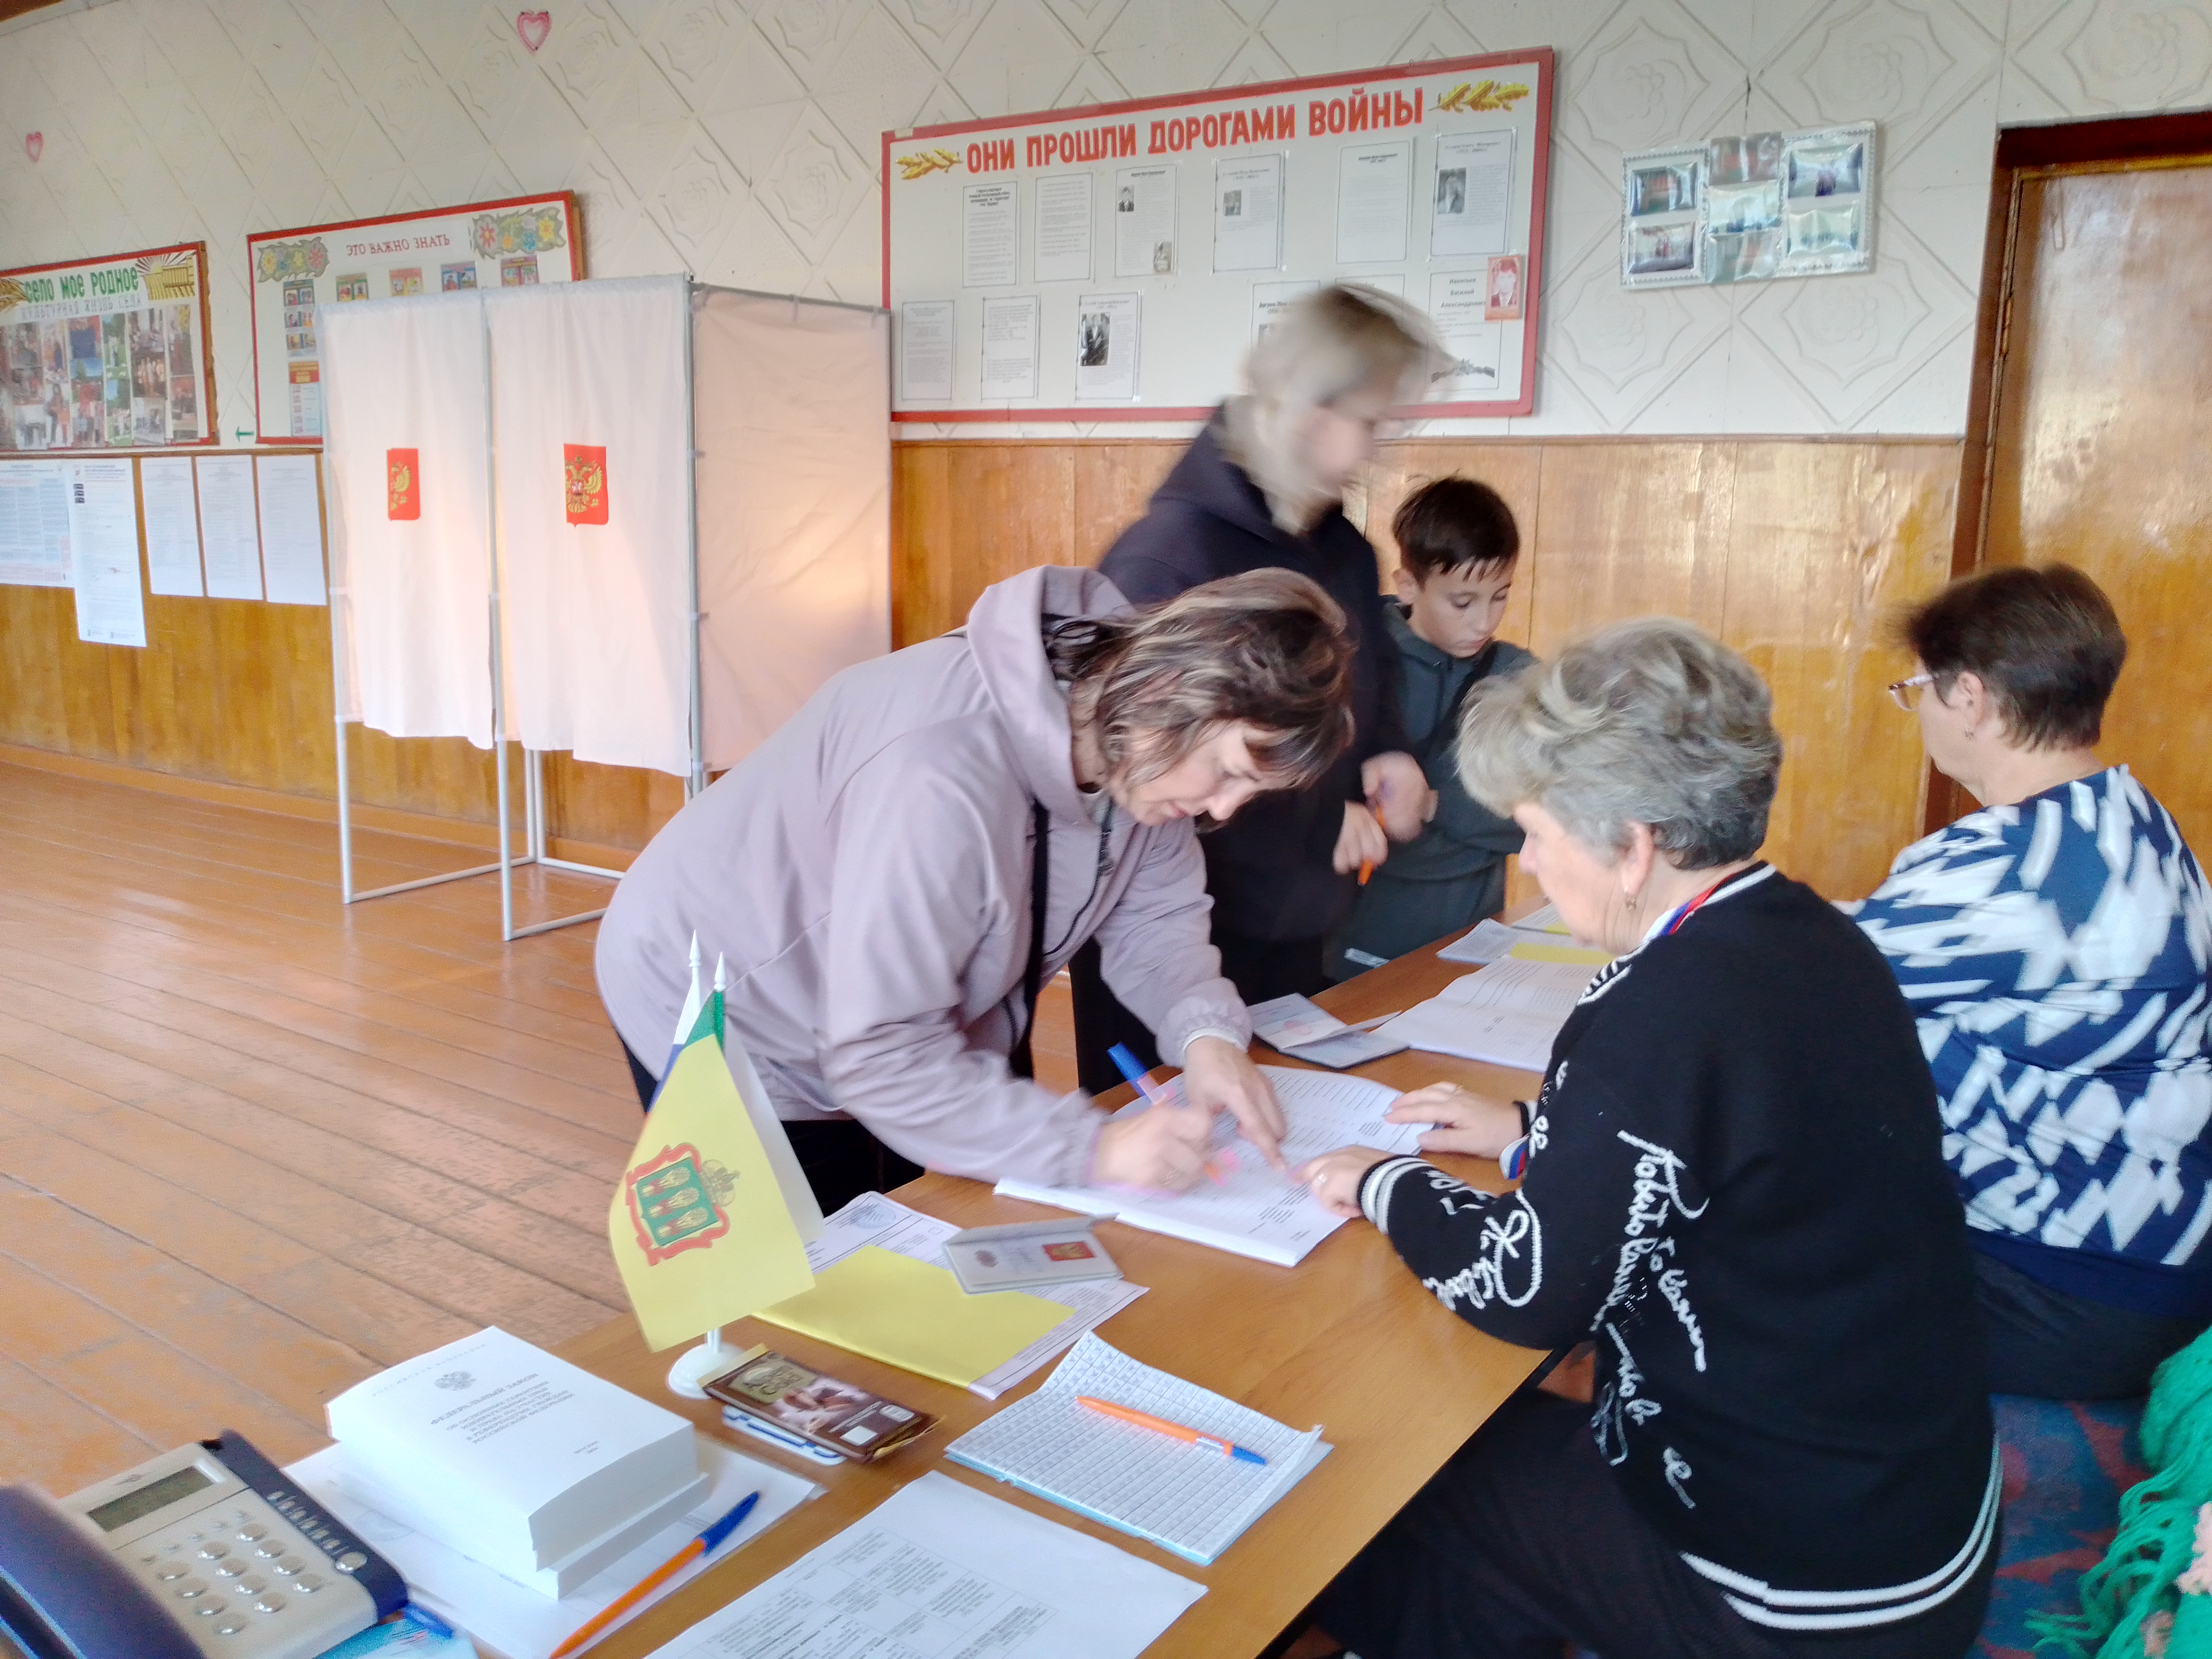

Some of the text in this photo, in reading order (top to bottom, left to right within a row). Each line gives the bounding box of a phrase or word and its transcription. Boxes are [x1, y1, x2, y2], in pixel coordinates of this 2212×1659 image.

[966, 87, 1423, 174] ОНИ ПРОШЛИ ДОРОГАМИ ВОЙНЫ
[346, 234, 450, 256] ЭТО ВАЖНО ЗНАТЬ
[118, 294, 142, 309] СЕЛА
[430, 1373, 539, 1425] ФЕДЕРАЛЬНЫЙ ЗАКОН
